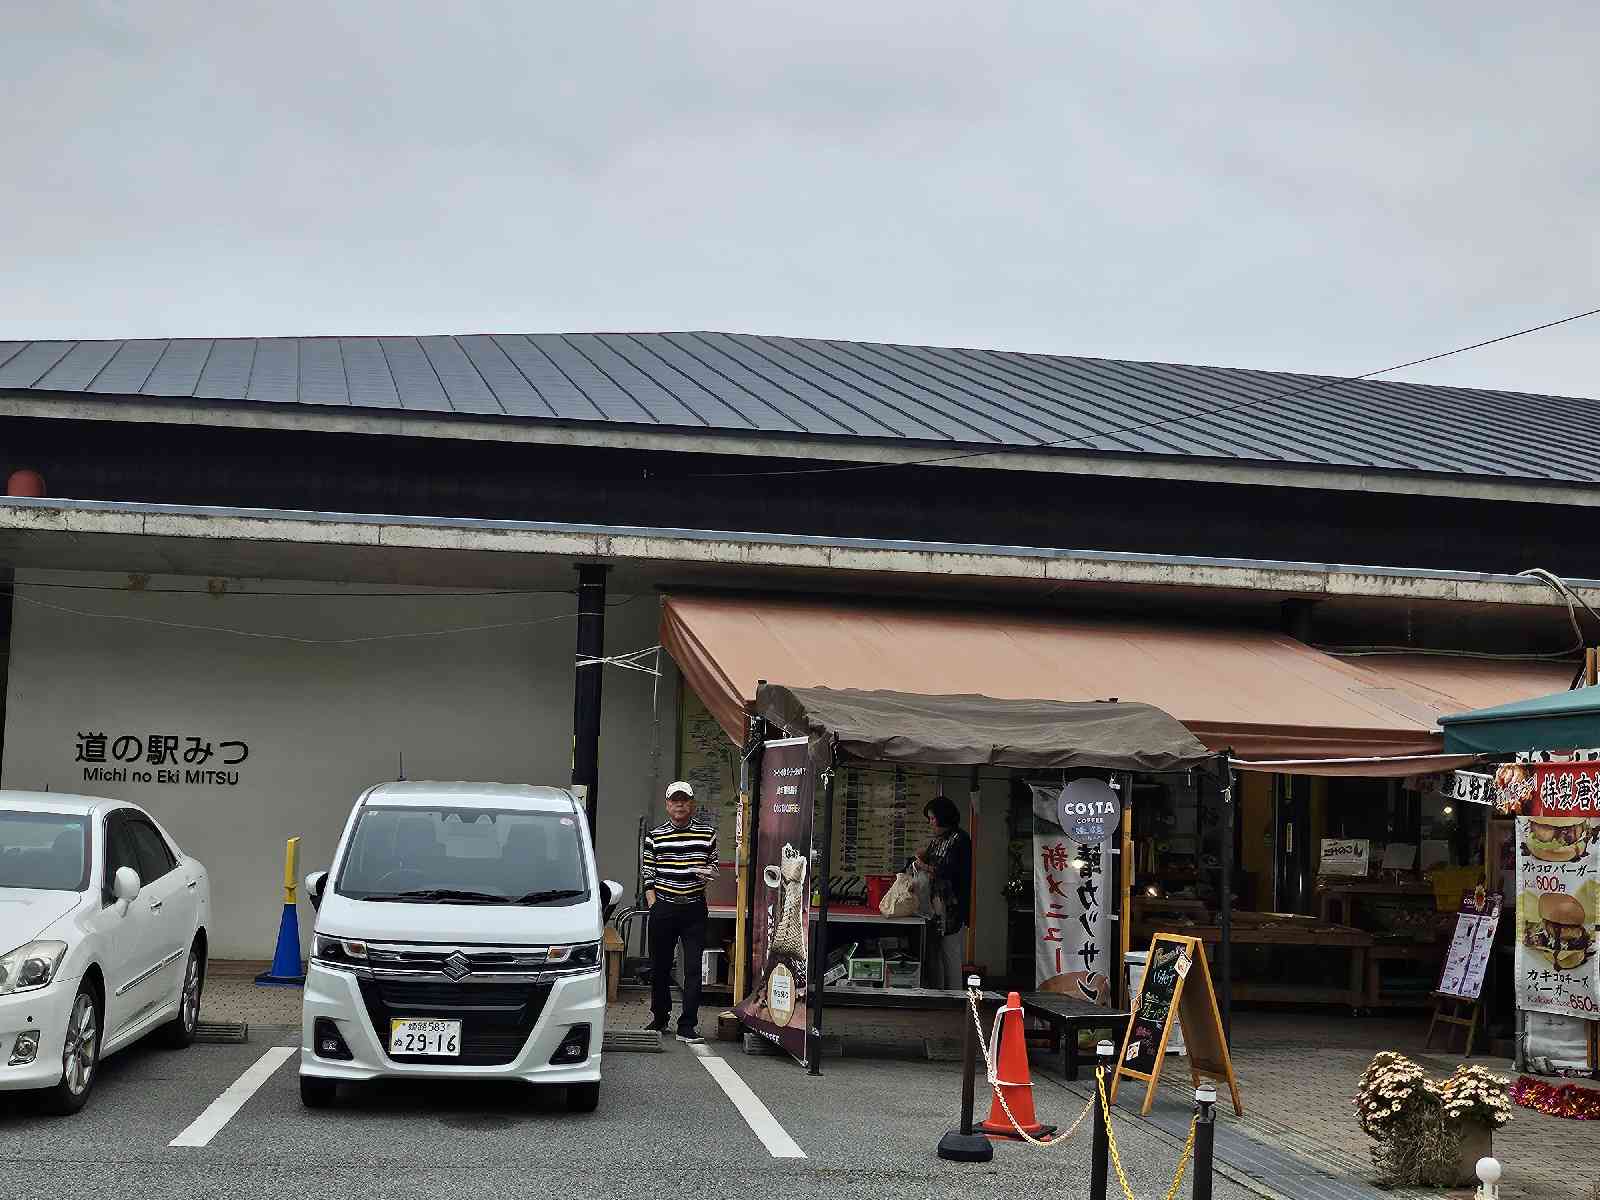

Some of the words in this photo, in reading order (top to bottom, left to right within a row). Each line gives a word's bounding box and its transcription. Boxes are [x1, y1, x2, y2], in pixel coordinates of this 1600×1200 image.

[75, 732, 249, 765] 道の駅みつ
[83, 767, 127, 782] Michi
[132, 771, 152, 783] no
[157, 769, 180, 784] Eki
[185, 770, 239, 785] MITSU
[1541, 771, 1600, 811] 特製唐
[1064, 801, 1115, 816] COSTA
[428, 1022, 446, 1032] 583
[405, 1033, 457, 1052] 29-16
